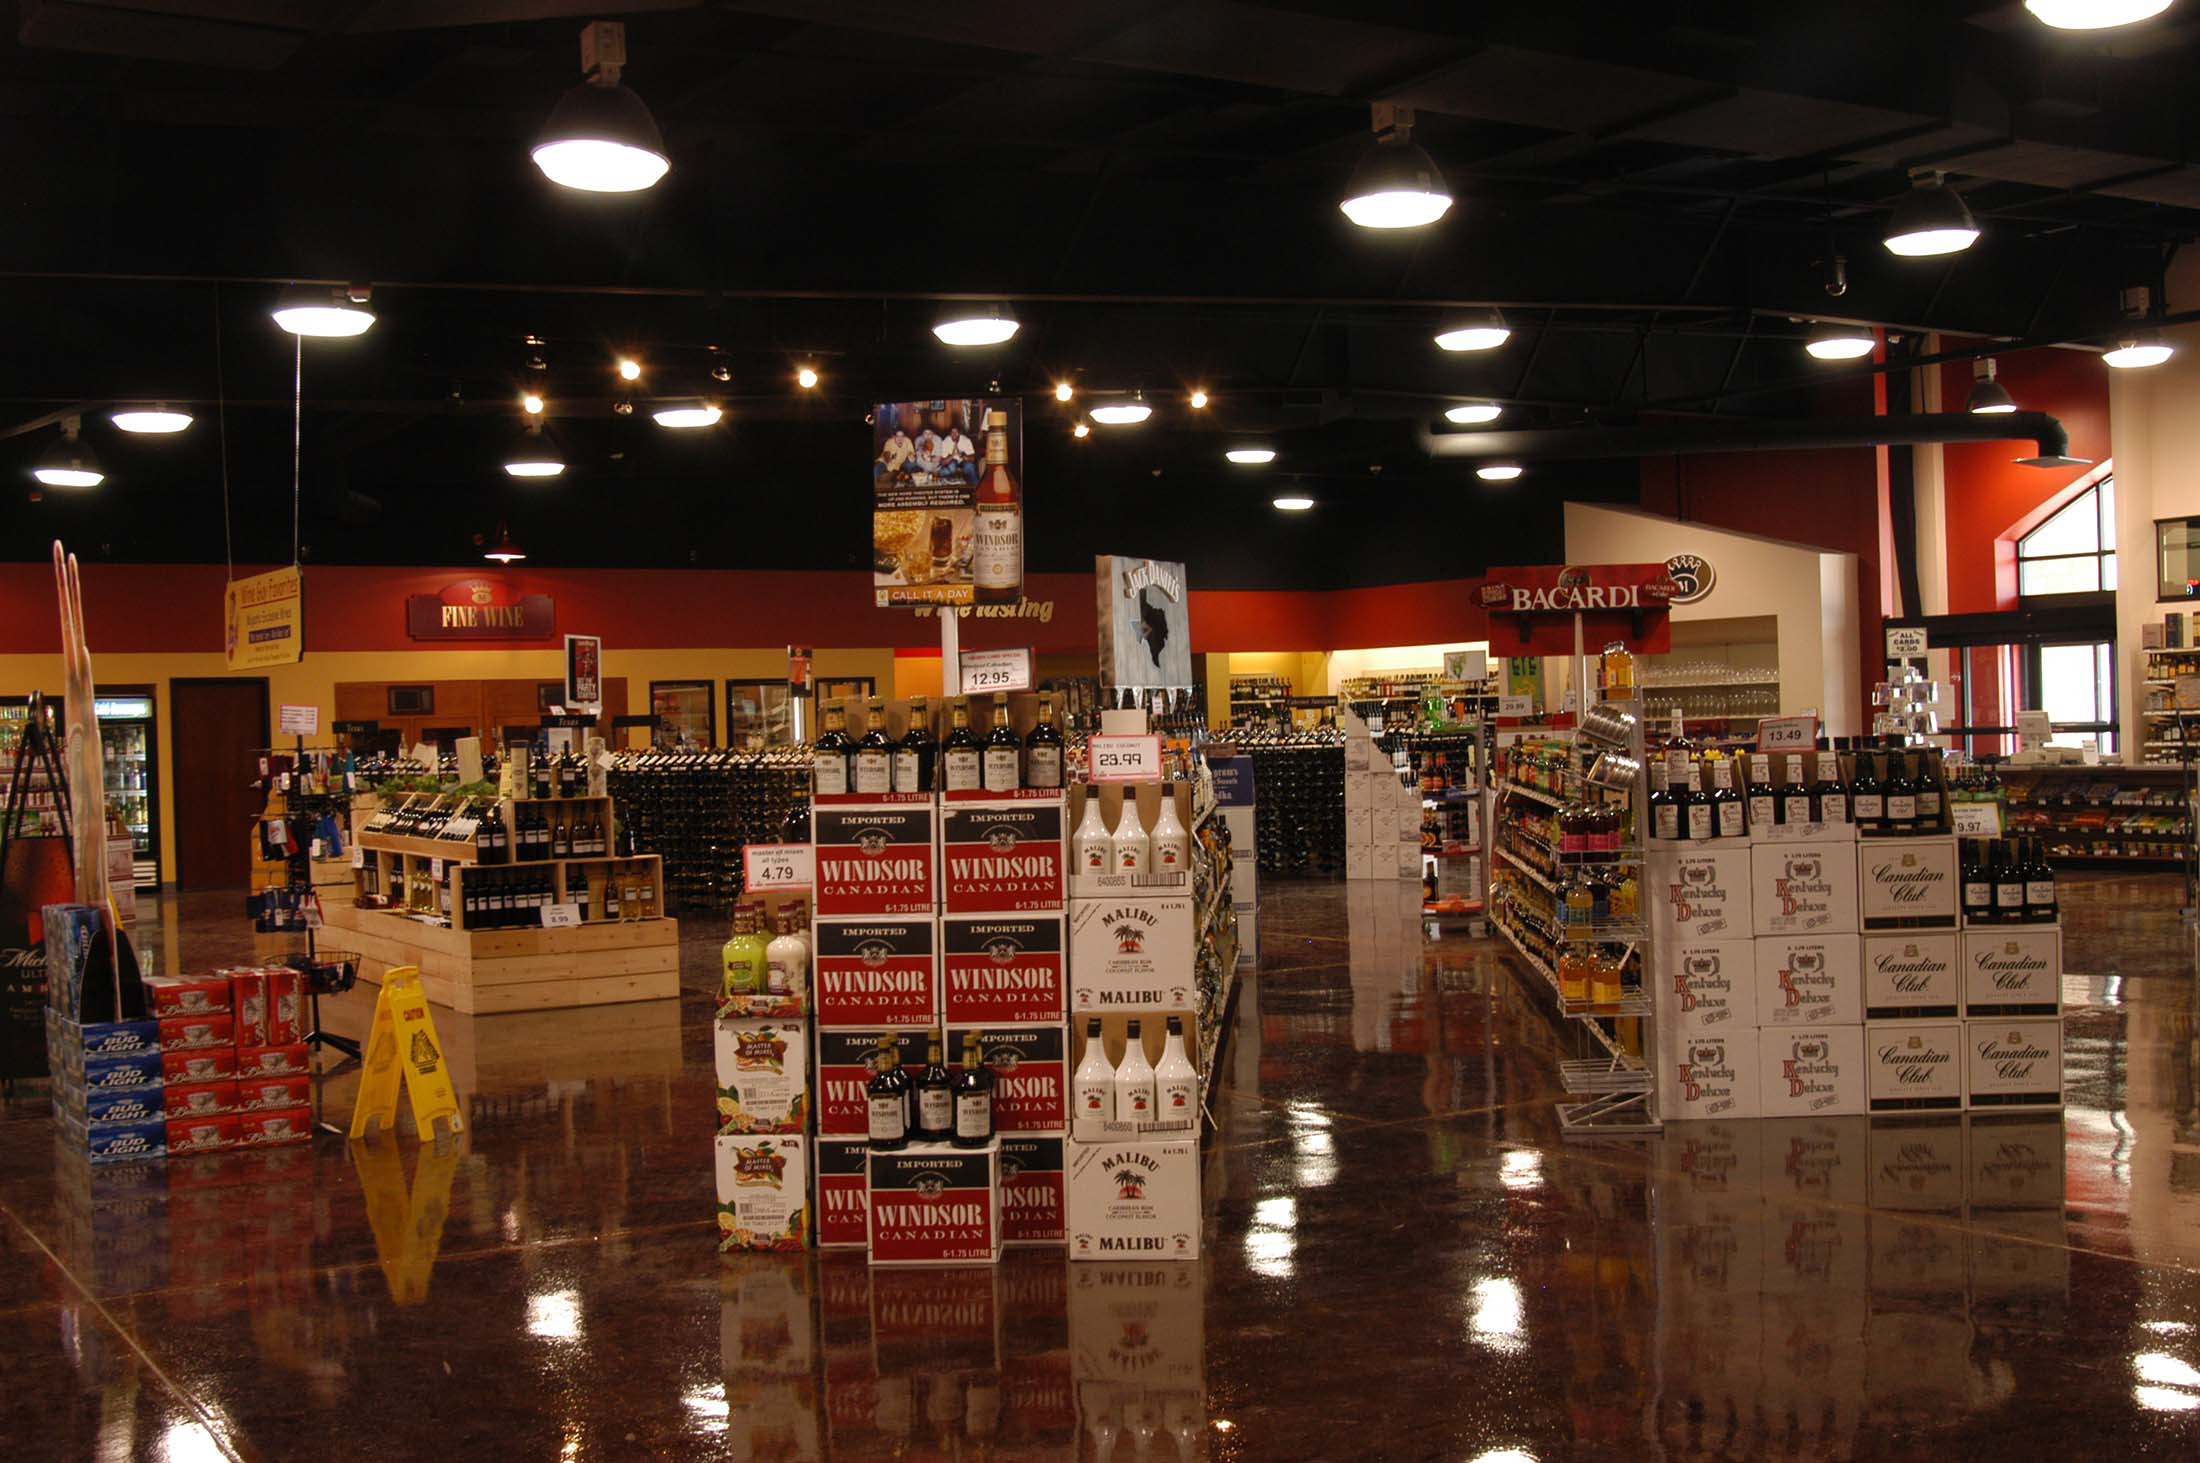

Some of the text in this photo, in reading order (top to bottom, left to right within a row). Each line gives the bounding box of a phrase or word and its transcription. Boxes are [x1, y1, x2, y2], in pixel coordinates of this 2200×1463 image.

[976, 534, 1018, 545] WINDSOR
[1128, 560, 1181, 603] JACK DANIEL'S
[892, 590, 969, 600] CALL IT A DAY
[1512, 585, 1640, 611] BACARDI
[441, 605, 524, 627] FINE WINE
[972, 672, 1009, 685] 12.95
[1768, 730, 1801, 741] 13.49
[1100, 754, 1142, 766] 23.99
[907, 792, 929, 801] LITRE
[1014, 789, 1059, 798] 6-1.75 LITRE
[970, 814, 1035, 822] IMPORTED
[1958, 822, 1982, 832] 9.97
[762, 866, 794, 881] 4.79
[822, 860, 927, 882] WINDSOR
[951, 856, 1056, 880] WINDSOR
[1872, 864, 1944, 884] Canadian
[824, 885, 925, 895] CANADIAN
[953, 882, 1055, 893] CANADIAN
[1670, 884, 1727, 904] Kentucky
[1776, 879, 1832, 897] Kentucky
[1890, 884, 1929, 903] Club
[886, 904, 931, 913] 6-1.75 LITRE
[1016, 900, 1061, 909] 6-1.75 LITRE
[1782, 898, 1827, 916] Deluxe
[1102, 908, 1159, 928] MALIBU
[1676, 904, 1722, 922] Deluxe
[842, 928, 907, 936] IMPORTED
[970, 925, 1035, 933] IMPORTED
[1874, 954, 1948, 974] Canadian
[1974, 952, 2048, 970] Canadian
[823, 971, 927, 993] WINDSOR
[951, 968, 1055, 991] WINDSOR
[1674, 975, 1731, 993] Kentucky
[1778, 970, 1835, 989] Kentucky
[1892, 974, 1928, 993] Club
[1992, 972, 2029, 991] Club
[826, 996, 926, 1006] CANADIAN
[952, 993, 1054, 1003] CANADIAN
[1100, 991, 1162, 1004] MALIBU
[1681, 994, 1726, 1012] Deluxe
[1785, 989, 1830, 1008] Deluxe
[886, 1014, 932, 1024] 6-1.75 LITRE
[1014, 1012, 1061, 1021] 6-1.75 LITRE
[104, 1035, 140, 1044] BUD
[846, 1038, 910, 1046] IMPOD
[982, 1034, 1038, 1043] MPORTED
[98, 1042, 145, 1052] LIGHT
[1978, 1041, 2050, 1061] Canadian
[1878, 1046, 1950, 1065] Canadian
[106, 1070, 143, 1079] BUD
[1679, 1064, 1735, 1083] Kentucky
[1783, 1060, 1839, 1079] Kentucky
[1896, 1066, 1934, 1084] Club
[1995, 1061, 2034, 1080] Club
[100, 1076, 147, 1087] LIGHT
[1790, 1079, 1834, 1097] Deluxe
[1686, 1083, 1731, 1101] Deluxe
[108, 1104, 144, 1113] BUD
[996, 1102, 1057, 1112] ADIAN
[102, 1110, 149, 1121] LIGHT
[1018, 1120, 1064, 1129] 6-1.75 LITRE
[104, 1144, 150, 1155] LIGHT
[110, 1138, 145, 1148] BUD
[897, 1160, 964, 1169] IMPORTED
[1102, 1152, 1159, 1173] MALIBU
[1000, 1187, 1056, 1208] DSOR
[877, 1204, 984, 1227] WINDSOR
[880, 1230, 984, 1241] CANADIAN
[1100, 1238, 1165, 1250] MALIBU
[943, 1249, 990, 1258] 6-1.75 LITRE
